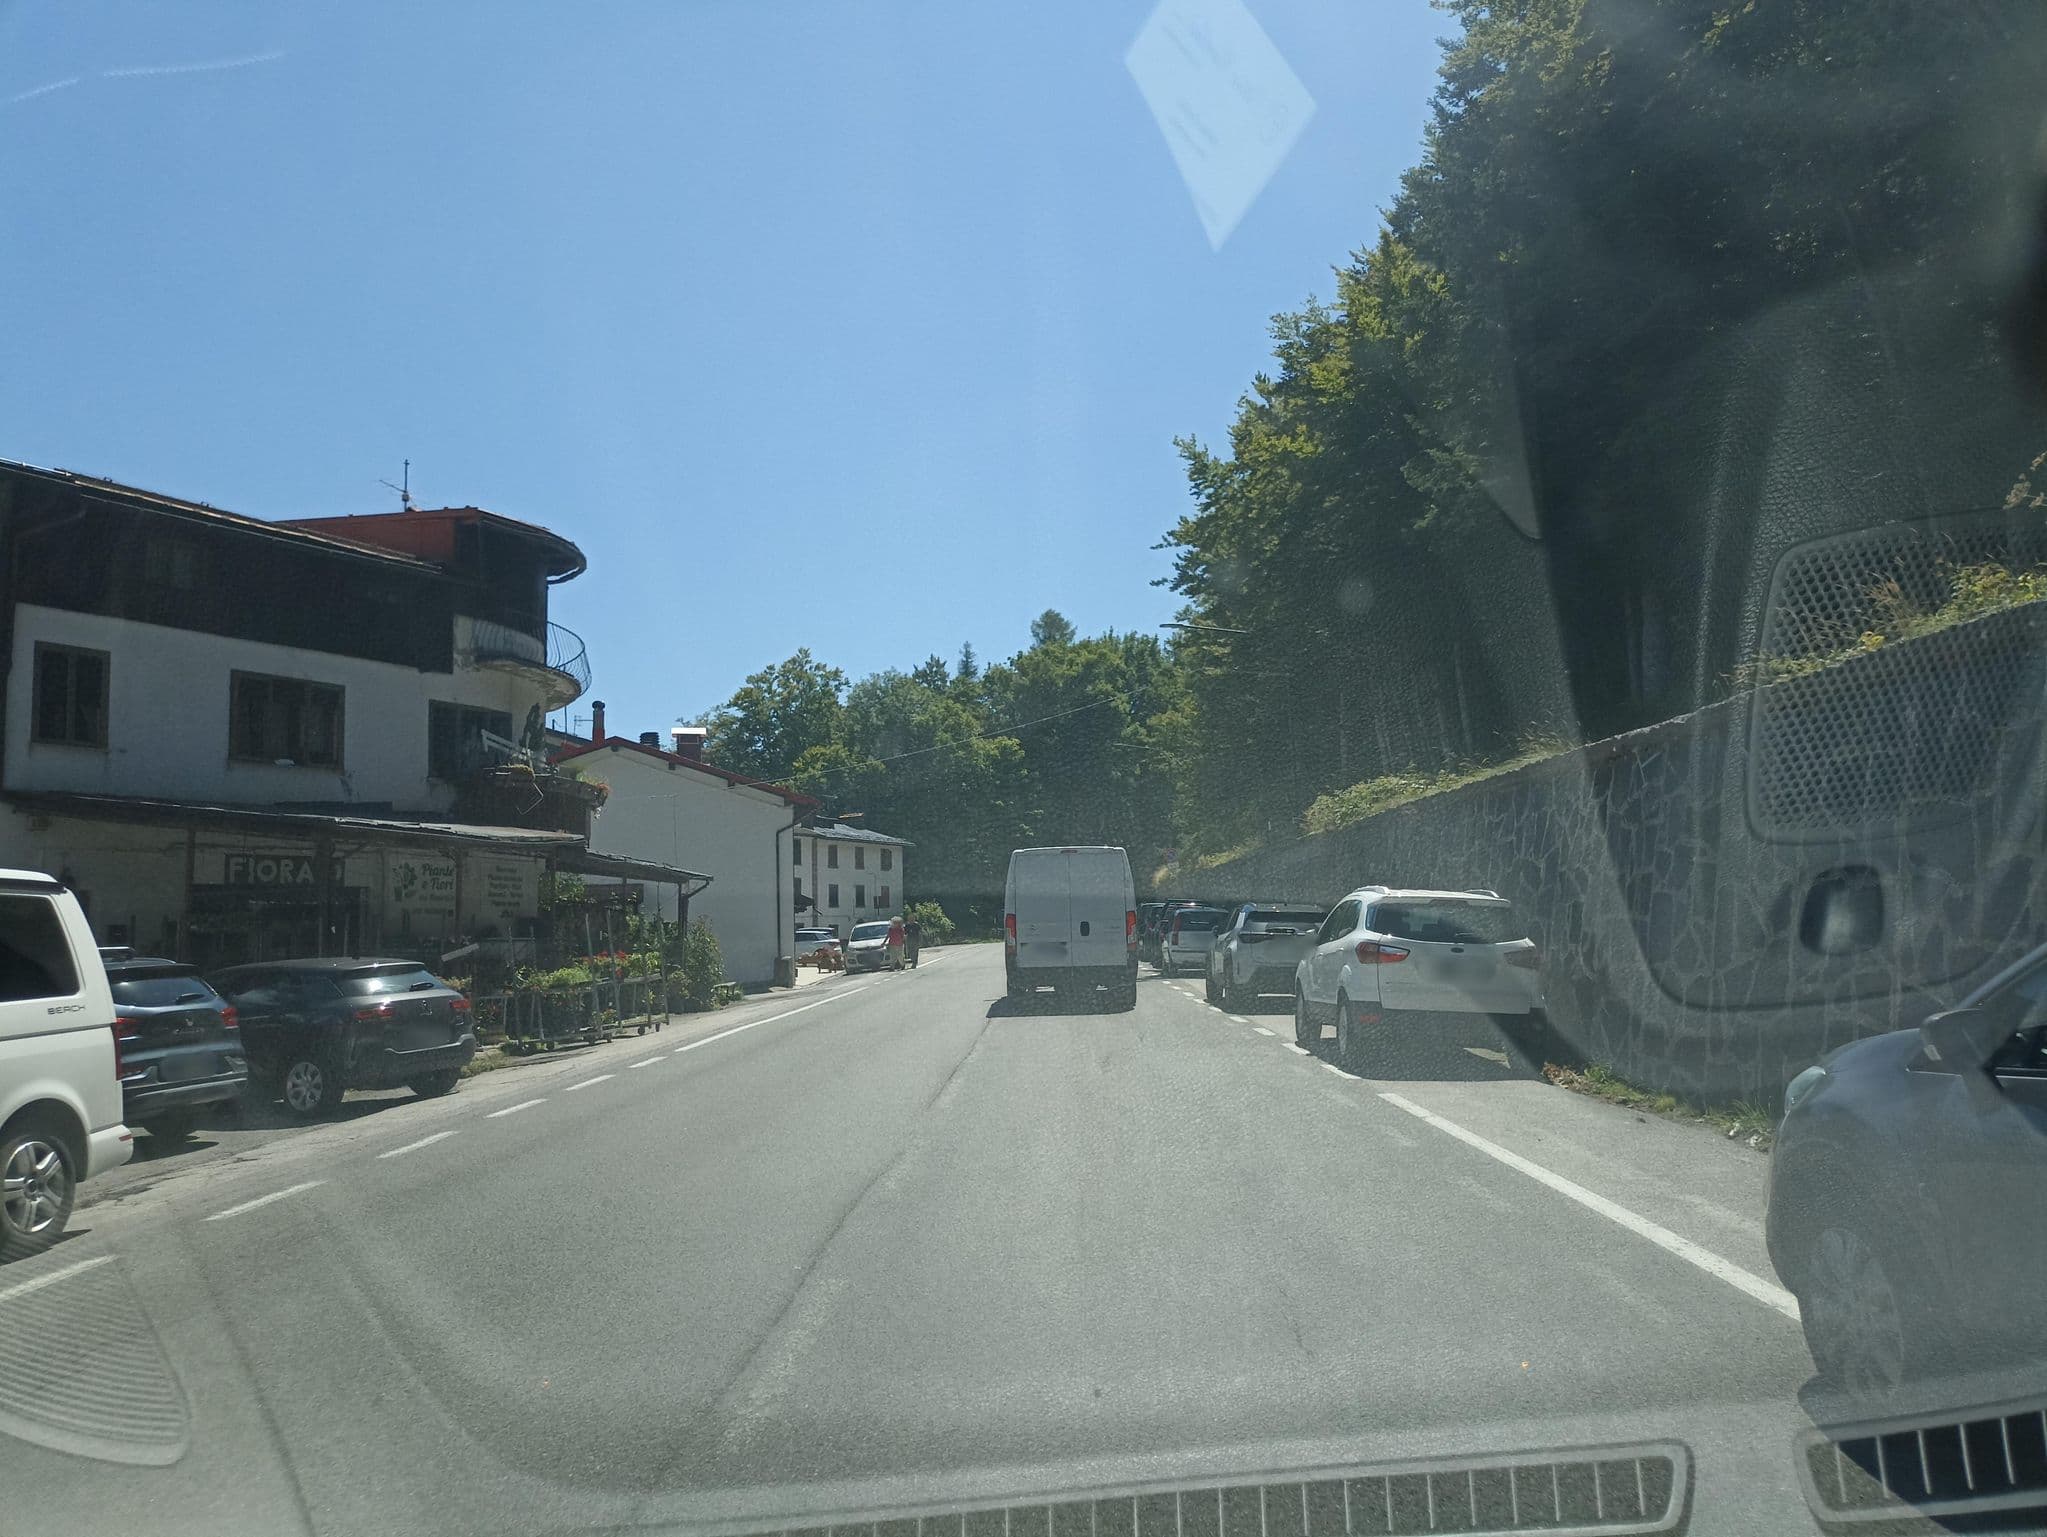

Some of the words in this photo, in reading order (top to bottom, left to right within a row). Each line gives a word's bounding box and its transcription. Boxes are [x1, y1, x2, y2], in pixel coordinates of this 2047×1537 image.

[229, 857, 343, 884] FIORA
[422, 863, 455, 877] Piante
[421, 880, 428, 890] e
[431, 877, 455, 890] Fiori
[47, 1004, 86, 1014] BEACH
